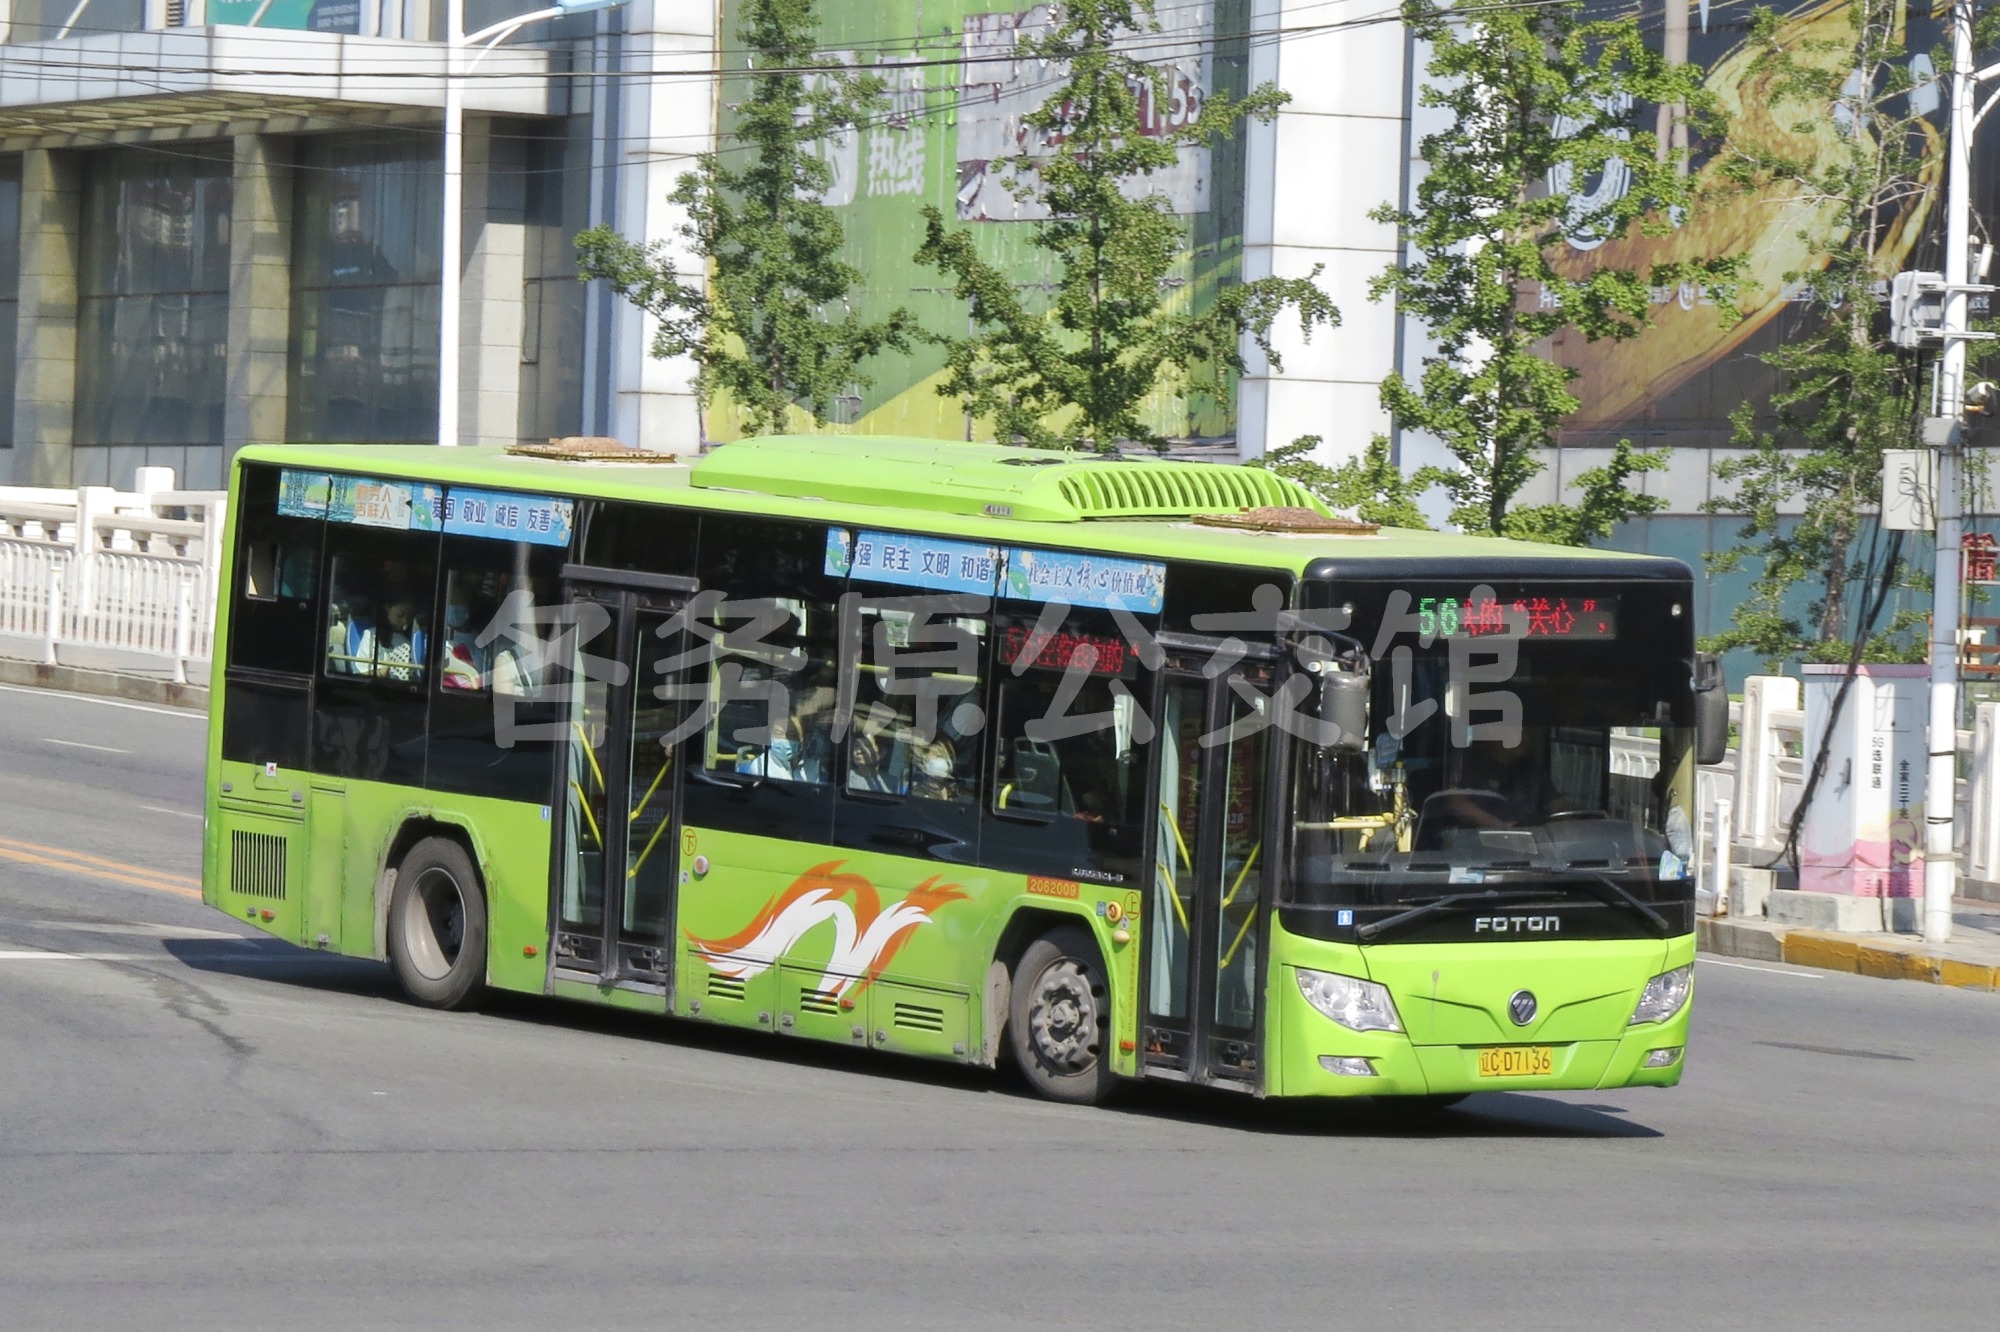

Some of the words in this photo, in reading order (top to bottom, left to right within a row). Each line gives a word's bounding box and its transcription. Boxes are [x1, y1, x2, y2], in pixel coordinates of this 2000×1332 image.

[868, 124, 926, 198] 热线
[432, 497, 455, 521] 爱国
[463, 500, 486, 524] 敬业
[495, 503, 519, 528] 诚信
[527, 507, 551, 532] 友善
[883, 546, 911, 571] 民主
[921, 551, 950, 577] 文明
[961, 555, 991, 581] 和谐
[1420, 598, 1458, 635] 56
[1030, 878, 1077, 897] 2062009
[1475, 915, 1561, 933] FOTON
